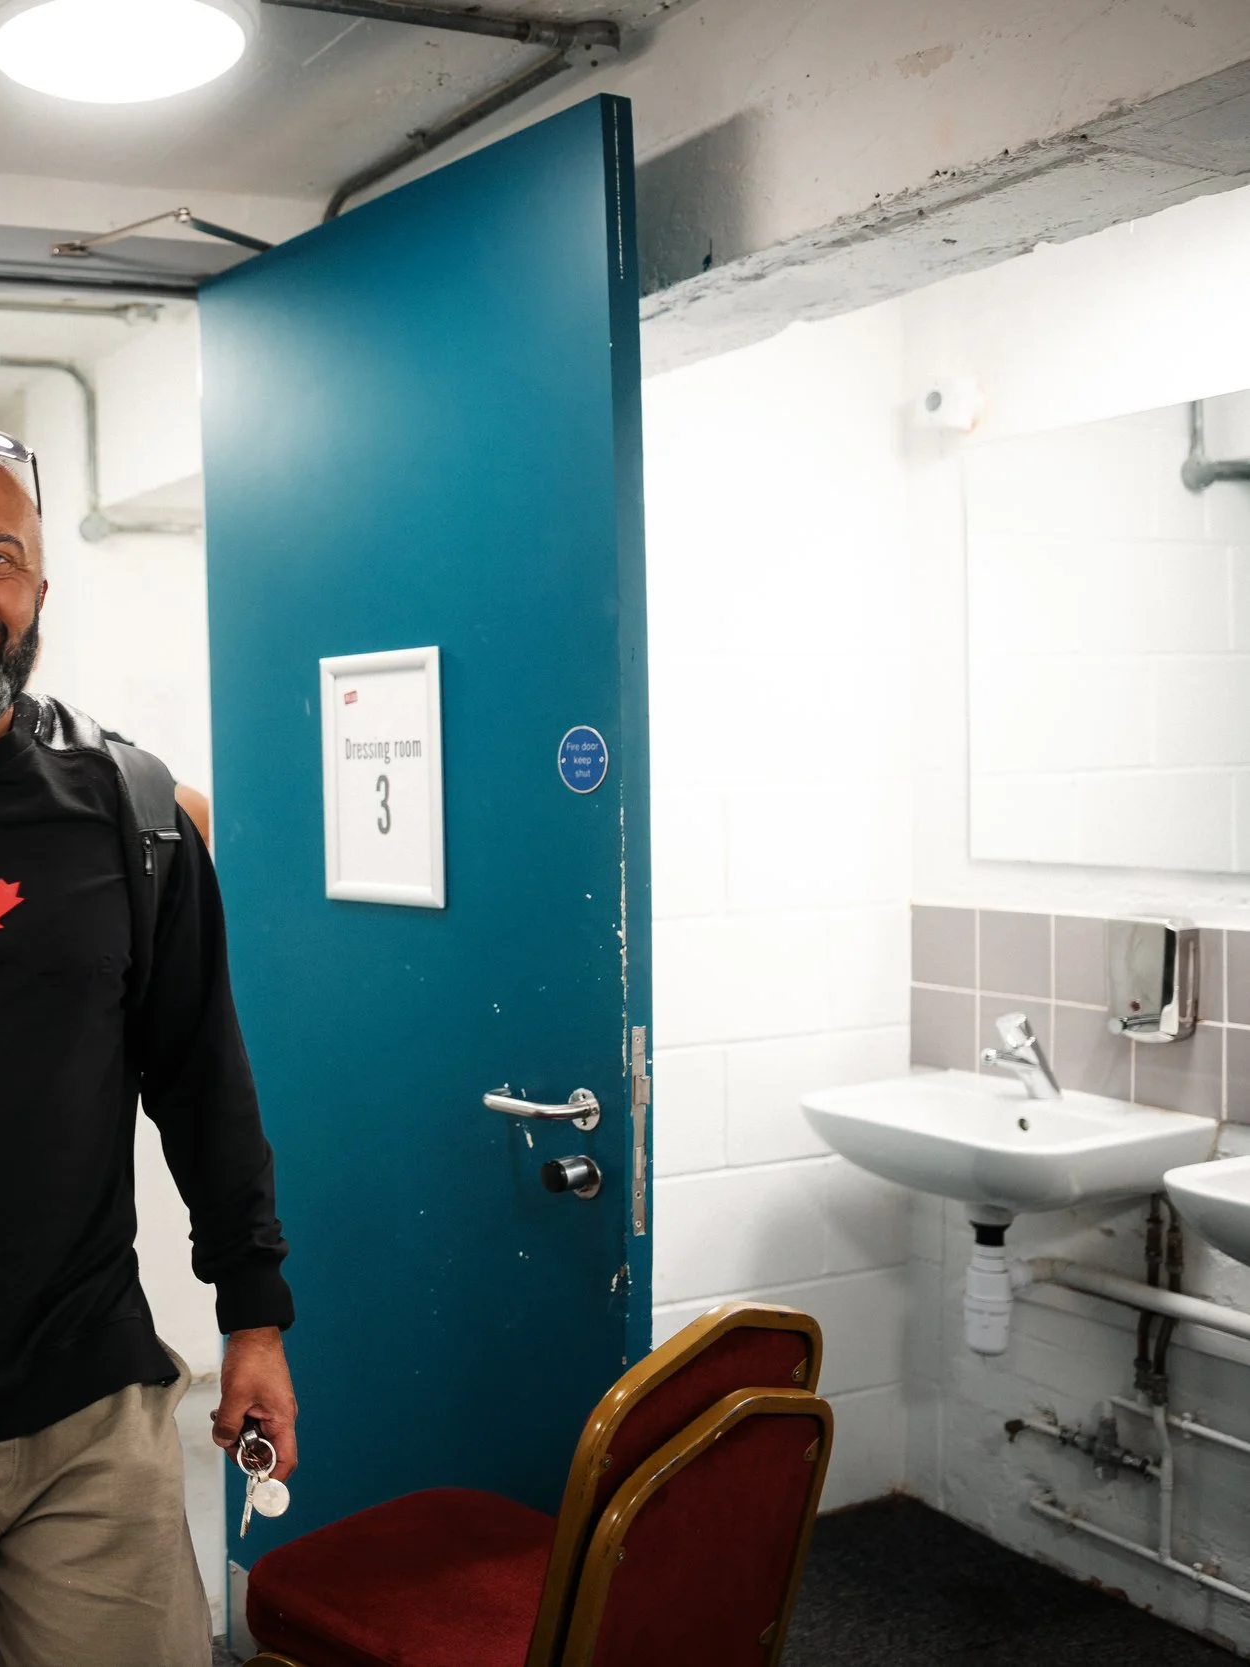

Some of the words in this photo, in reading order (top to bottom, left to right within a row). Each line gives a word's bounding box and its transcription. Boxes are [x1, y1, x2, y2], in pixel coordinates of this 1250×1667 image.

[345, 738, 391, 764] Dressing
[394, 739, 422, 758] room
[566, 742, 580, 751] Fire
[581, 742, 599, 751] door
[573, 756, 592, 766] keep
[574, 769, 591, 778] shut
[376, 775, 391, 834] 3
